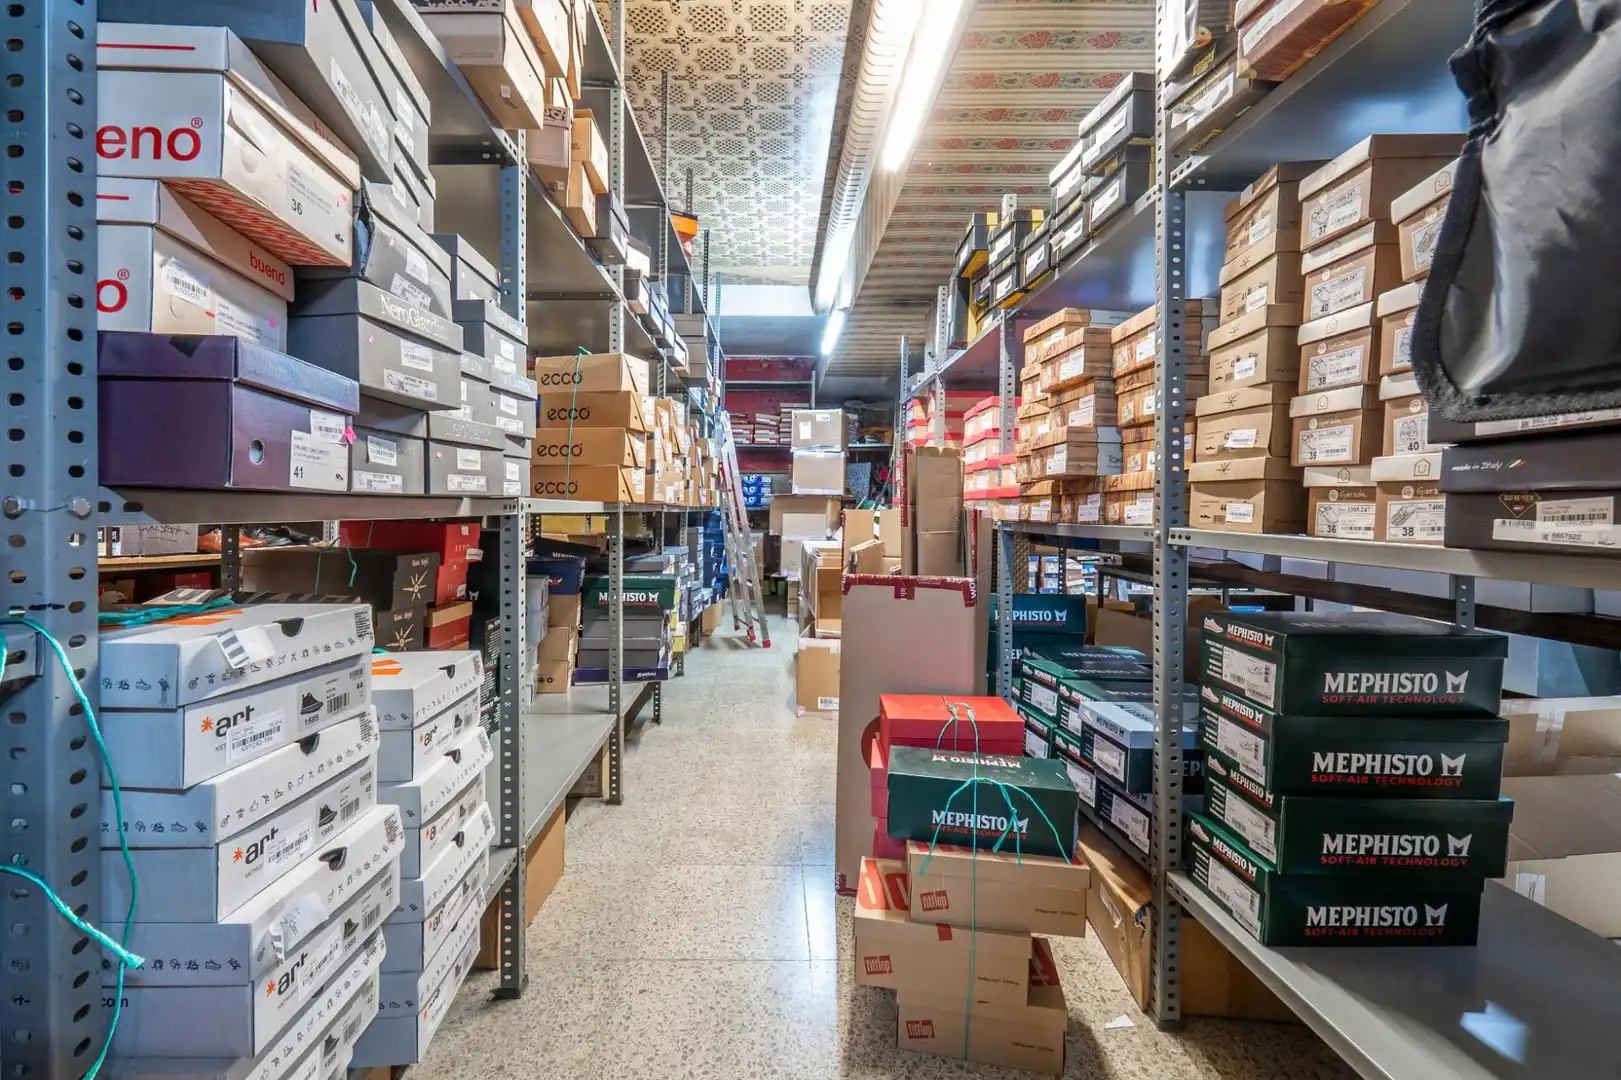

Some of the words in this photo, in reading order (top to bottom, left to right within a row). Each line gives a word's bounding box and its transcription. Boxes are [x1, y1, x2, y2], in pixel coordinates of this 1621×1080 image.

[291, 199, 303, 215] 36
[249, 251, 285, 286] bueno
[541, 372, 583, 386] ecco
[547, 406, 591, 421] ecco
[537, 443, 583, 457] ecco
[1407, 442, 1419, 451] 40
[293, 465, 304, 479] 41
[534, 481, 578, 495] ecco
[1326, 525, 1337, 534] 36
[1401, 526, 1414, 537] 38
[1227, 624, 1264, 643] MEPHISTO
[1324, 672, 1438, 694] MEPHISTO
[1321, 694, 1378, 704] SOFT-AIR
[1382, 694, 1466, 704] TECHNOLOGY
[1222, 695, 1255, 720] MEPHISTO
[1312, 751, 1434, 776] MEPHISTO
[1229, 768, 1264, 798] MEPHISTO
[1311, 774, 1369, 783] SOFT-AIR
[1374, 776, 1463, 786] TECHNOLOGY
[931, 810, 1008, 831] MEPHISTO
[1322, 833, 1440, 856] MEPHISTO
[1212, 836, 1247, 869] MEPHISTO
[1320, 856, 1378, 865] SOFT-AIR
[1382, 856, 1469, 867] TECHNOLOGY
[1306, 905, 1419, 927] MEPHISTO
[1304, 928, 1360, 937] SOFT-AIR
[1363, 928, 1445, 937] TECHNOLOGY
